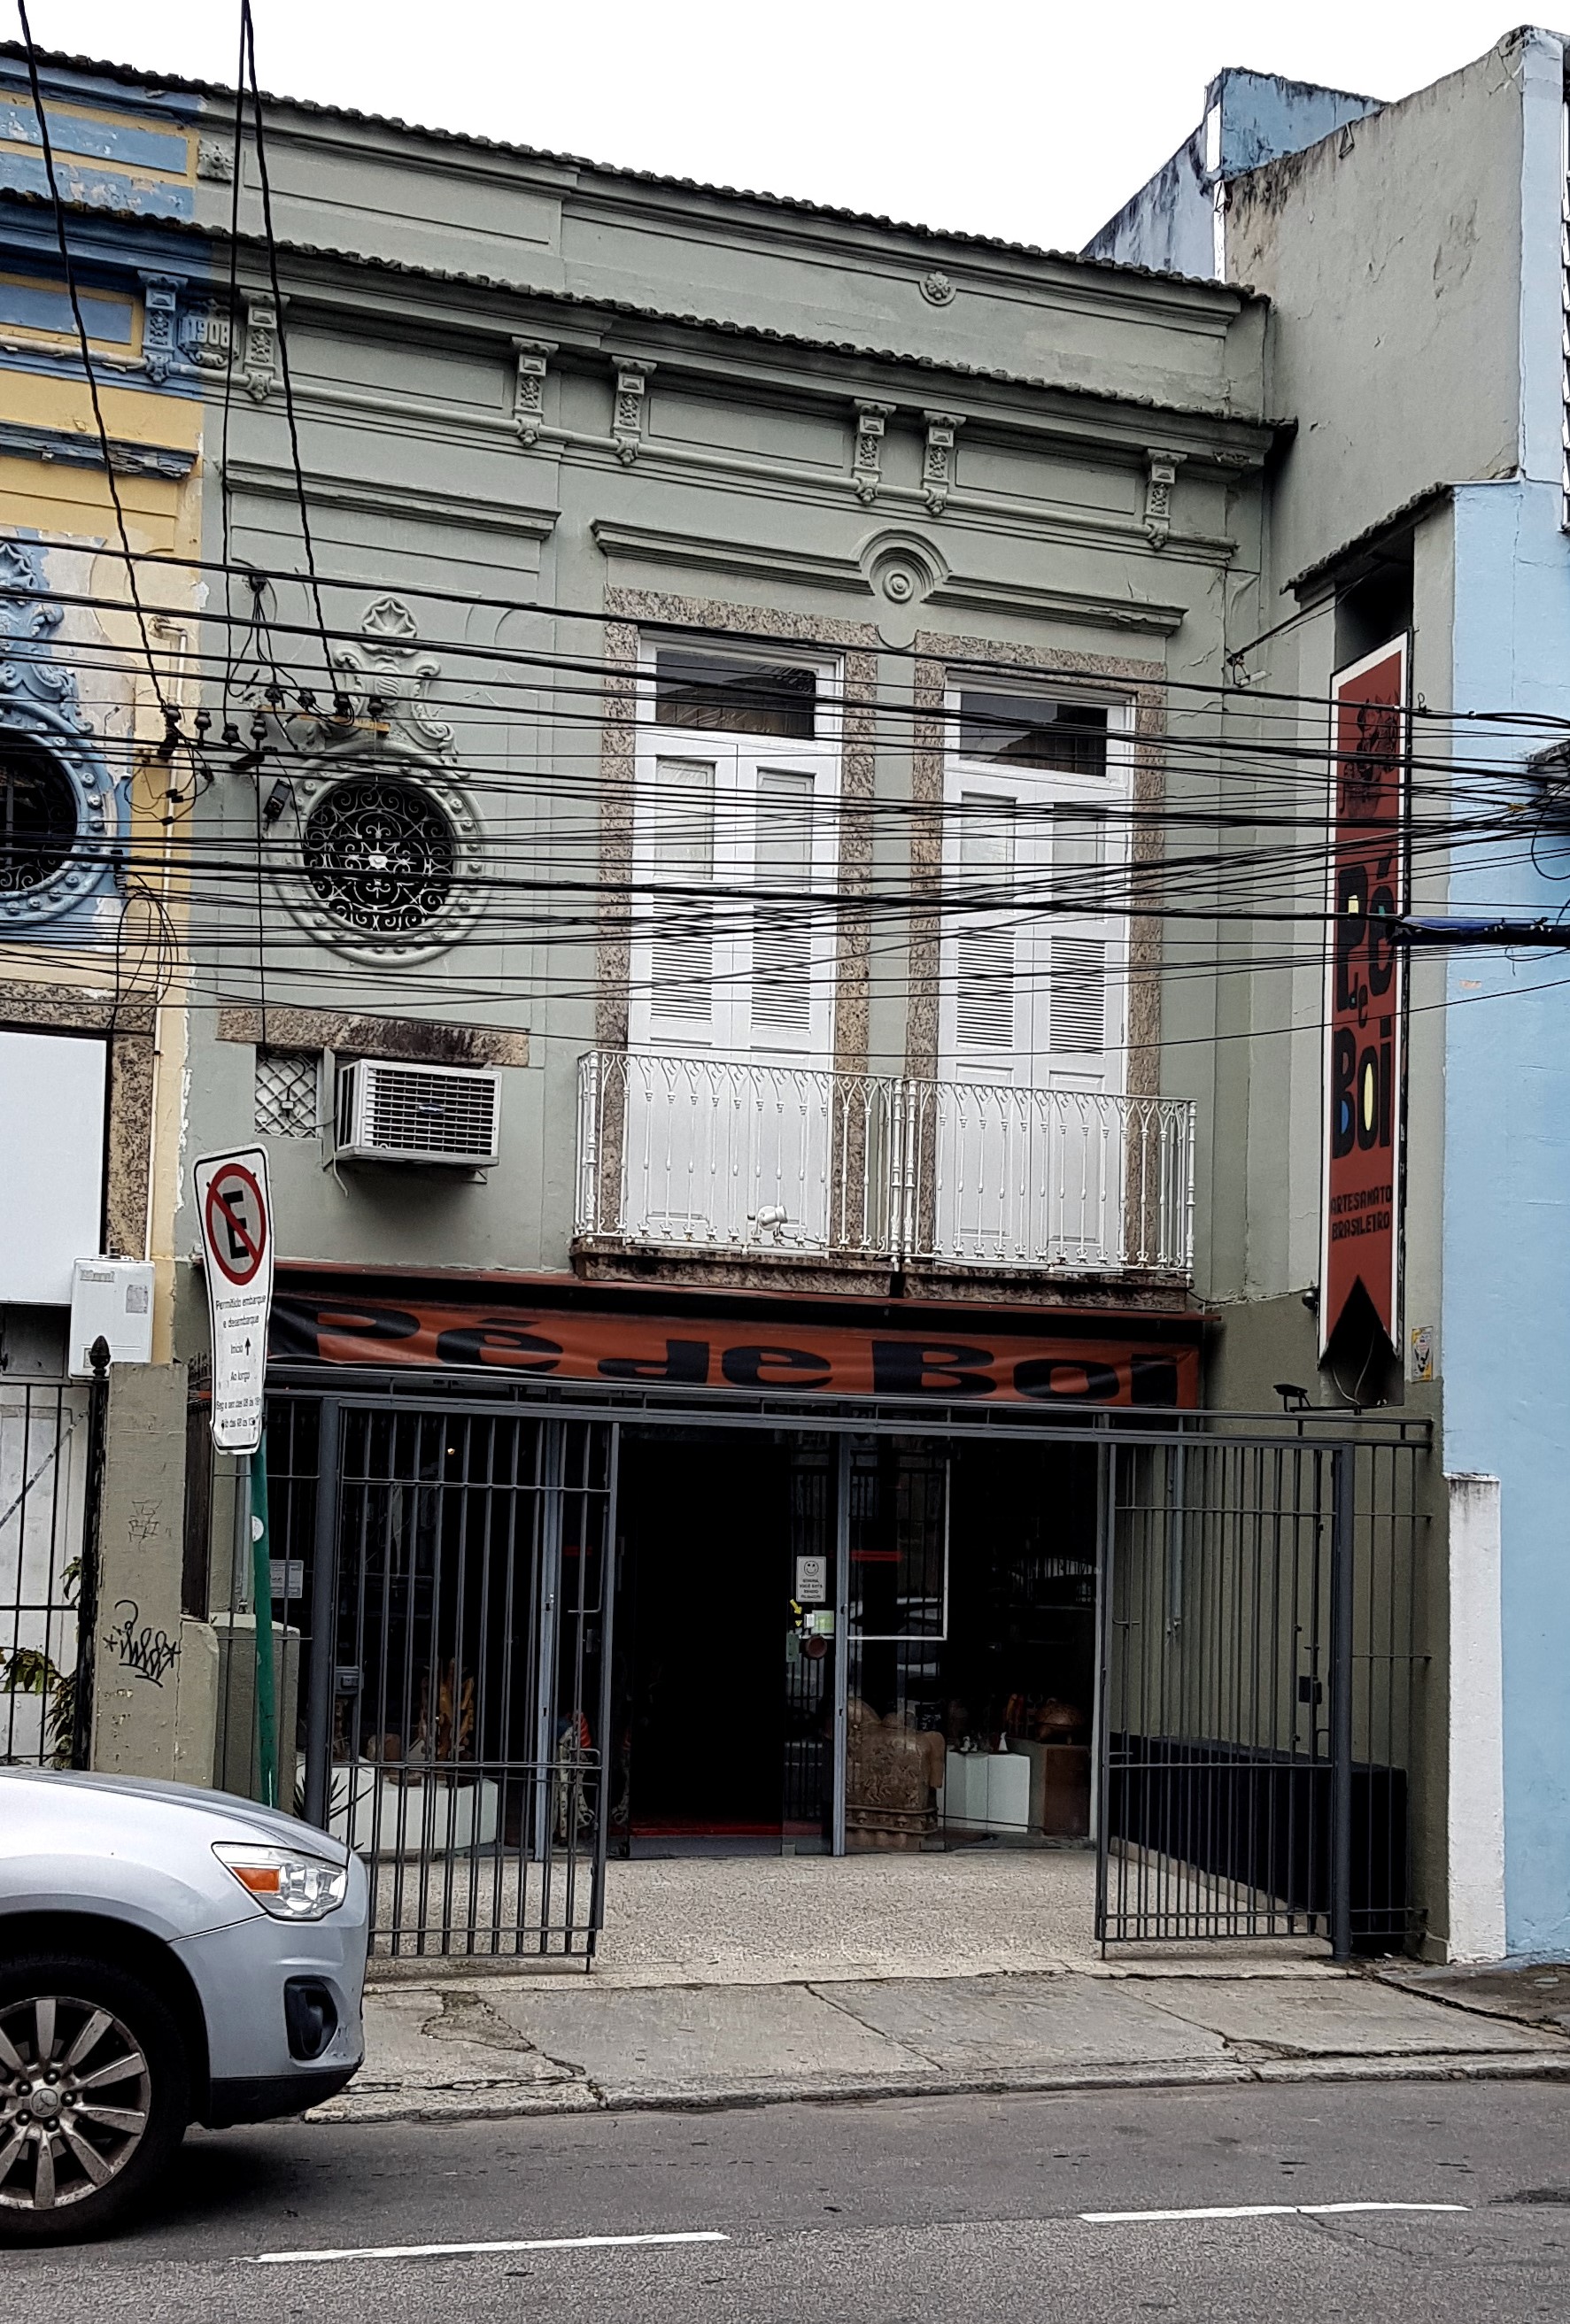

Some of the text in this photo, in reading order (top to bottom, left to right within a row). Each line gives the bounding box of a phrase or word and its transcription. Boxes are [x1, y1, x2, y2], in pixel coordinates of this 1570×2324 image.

[187, 319, 231, 349] 1908
[1349, 971, 1368, 1029] de
[1332, 1015, 1392, 1160] Boi
[1331, 1185, 1392, 1216] ARTESANATO
[1332, 1210, 1390, 1242] BRASILEIRO
[268, 1298, 1179, 1407] Pé de Boi
